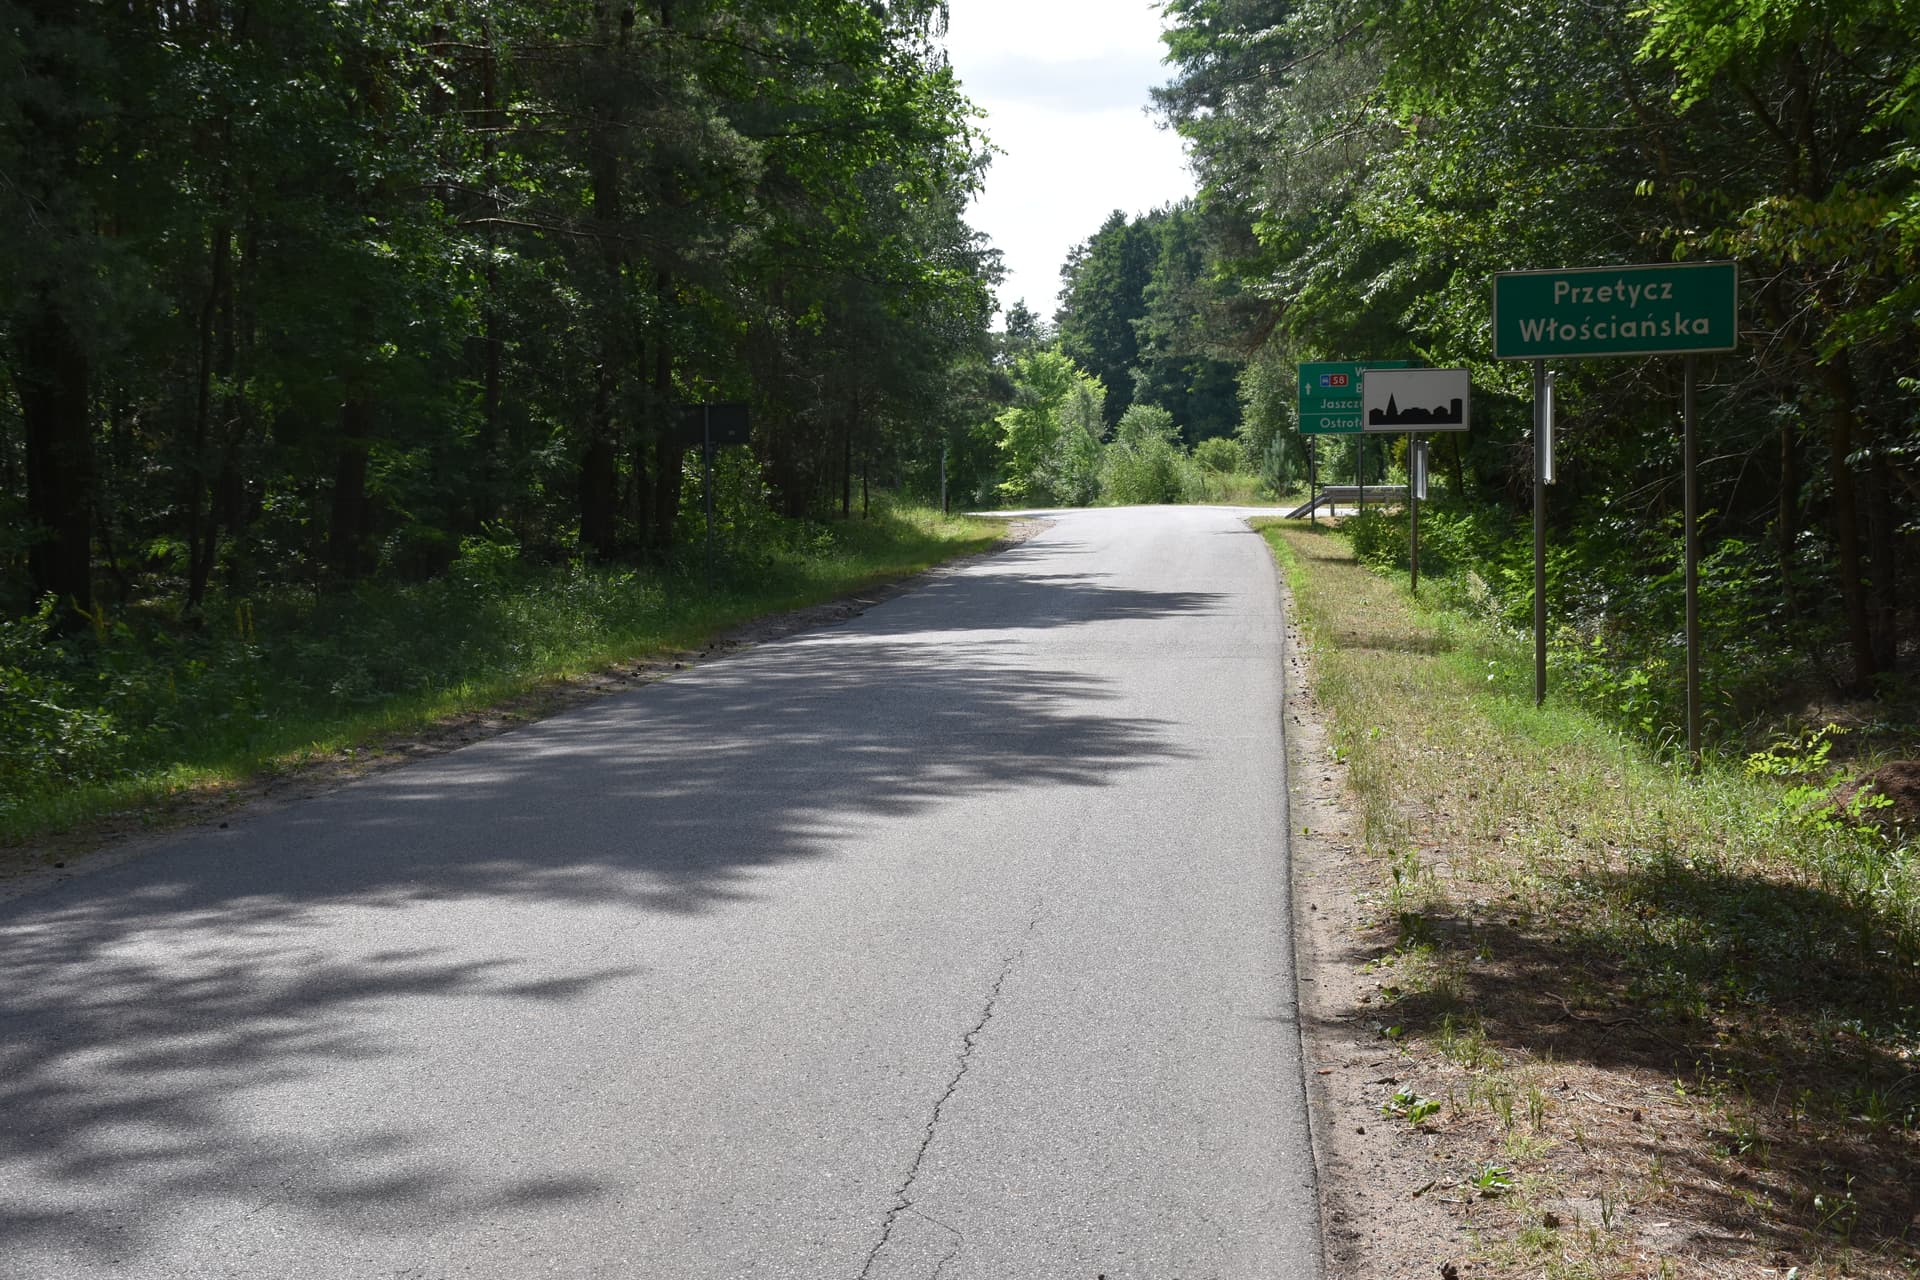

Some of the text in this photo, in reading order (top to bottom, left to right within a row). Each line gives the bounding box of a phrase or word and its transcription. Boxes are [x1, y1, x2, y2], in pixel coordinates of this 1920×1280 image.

[1554, 279, 1673, 308] Przetycz
[1519, 312, 1710, 342] Włościańska
[1320, 417, 1363, 429] Ostroł
